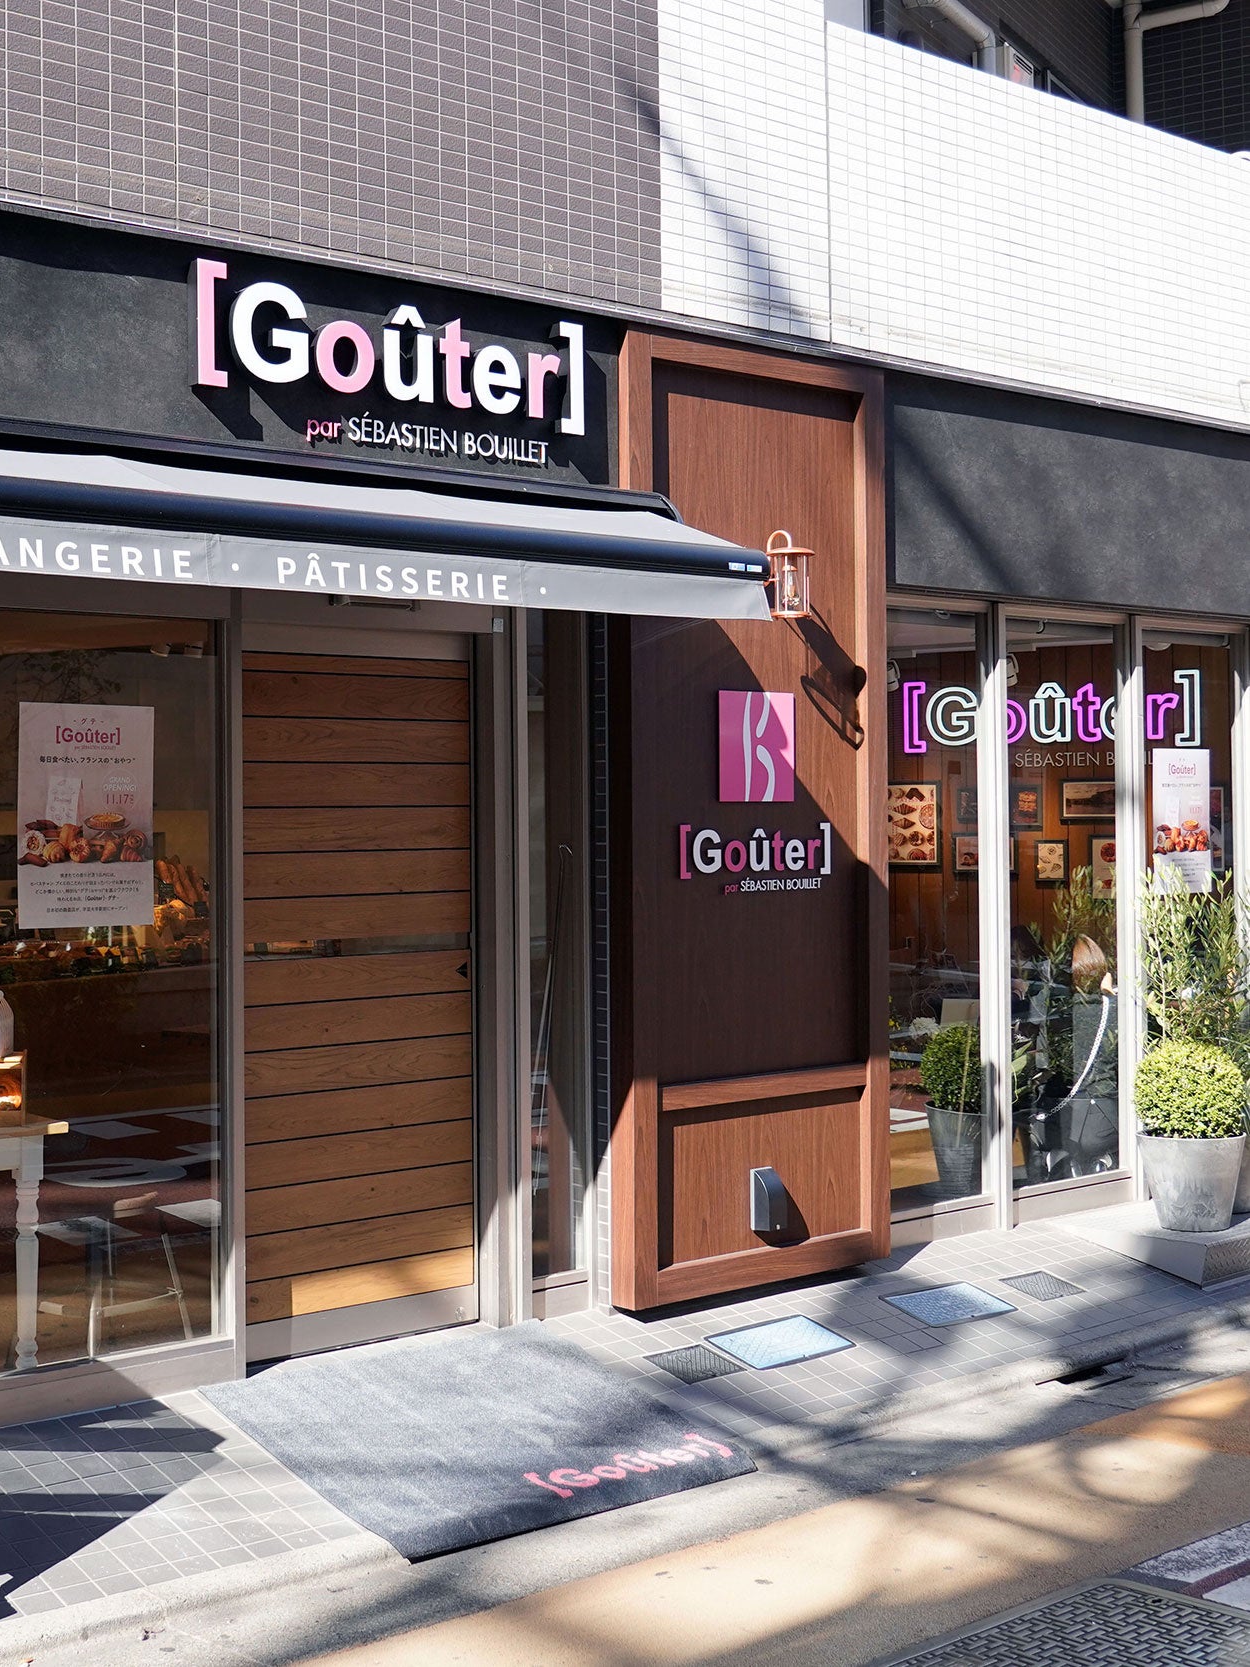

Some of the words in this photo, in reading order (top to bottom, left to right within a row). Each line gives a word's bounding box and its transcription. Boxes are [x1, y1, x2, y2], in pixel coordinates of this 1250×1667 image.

[193, 257, 586, 437] [Goûter]
[305, 418, 342, 442] par
[348, 411, 459, 454] SÉBASTIEN
[463, 431, 549, 464] BOUILLET
[276, 552, 510, 601] PÂTISSERIE
[1014, 749, 1100, 768] SÉBASTIEN
[679, 822, 831, 880] [Goûter]
[724, 884, 739, 896] par
[740, 876, 785, 892] SÉBASTIEN
[786, 877, 822, 890] BOUILLET
